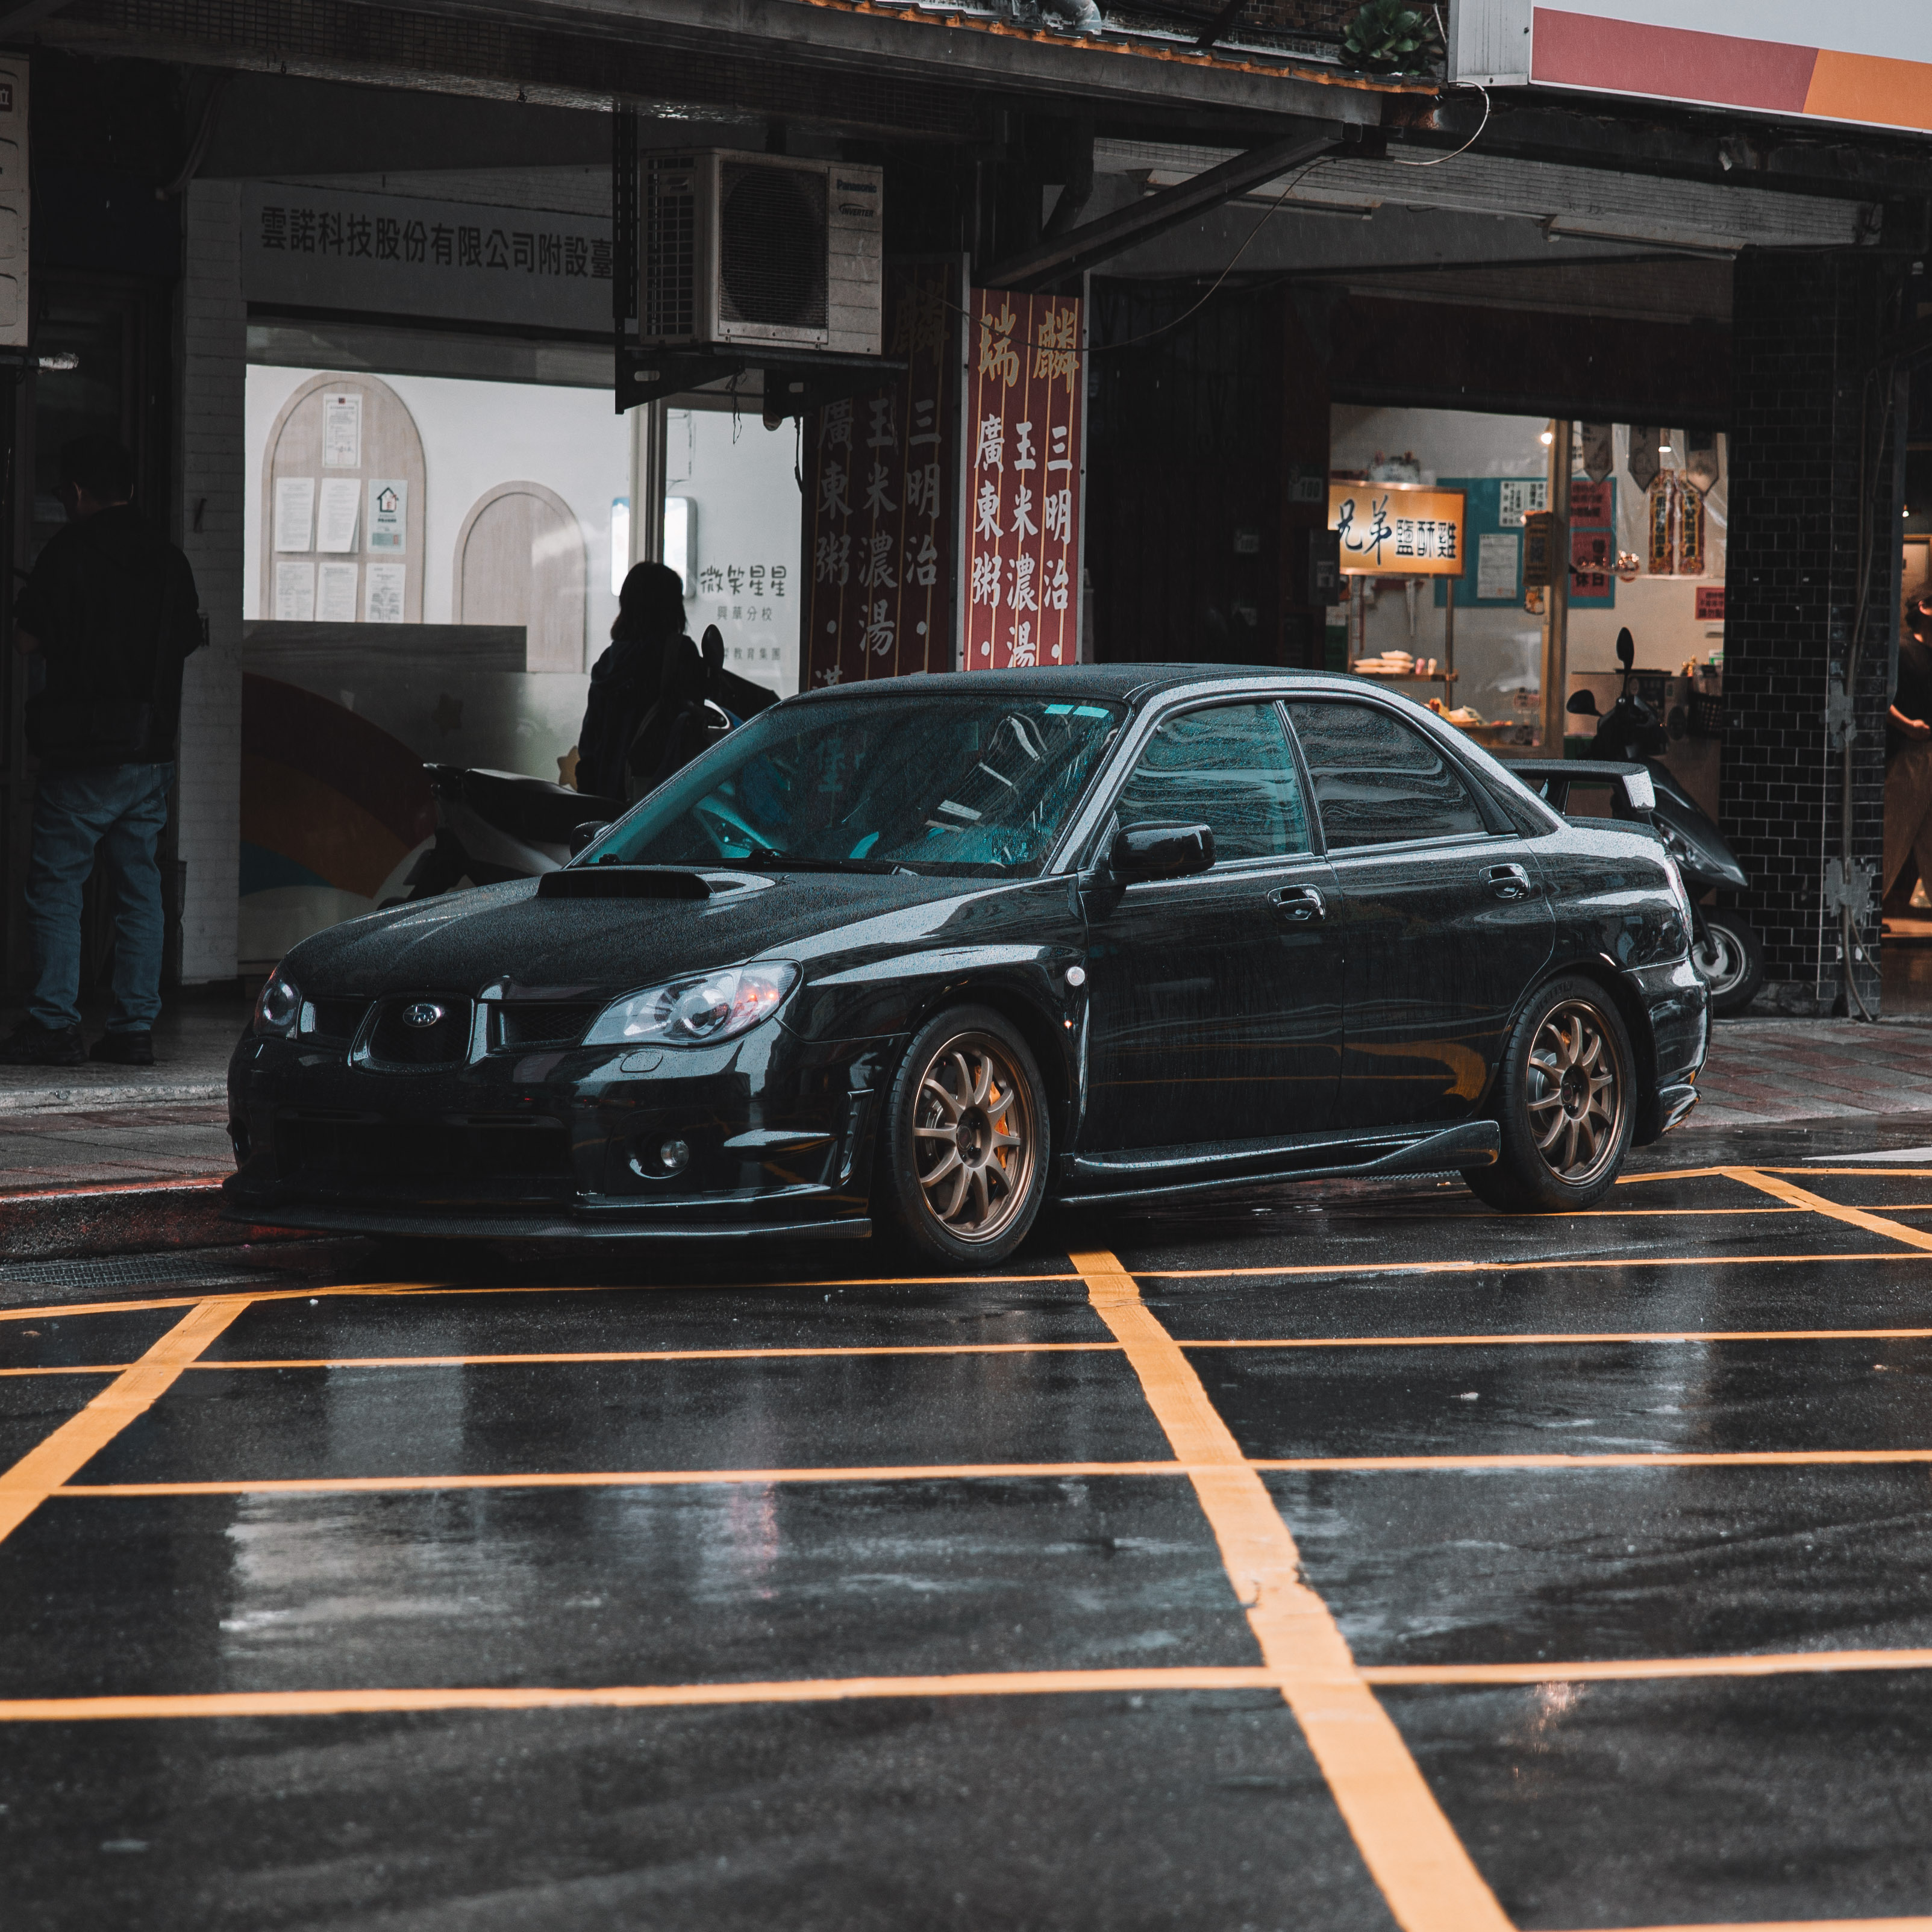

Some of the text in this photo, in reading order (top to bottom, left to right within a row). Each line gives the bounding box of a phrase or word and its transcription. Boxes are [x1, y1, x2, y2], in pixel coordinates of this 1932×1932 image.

[837, 179, 877, 193] Panasonic
[842, 207, 874, 217] INVERTER
[261, 207, 613, 280] 雲諾科技股份有限公司附設臺
[858, 399, 898, 655] 玉米濃湯
[1006, 422, 1038, 669] 玉米濃湯
[700, 564, 787, 596] 微笑星星
